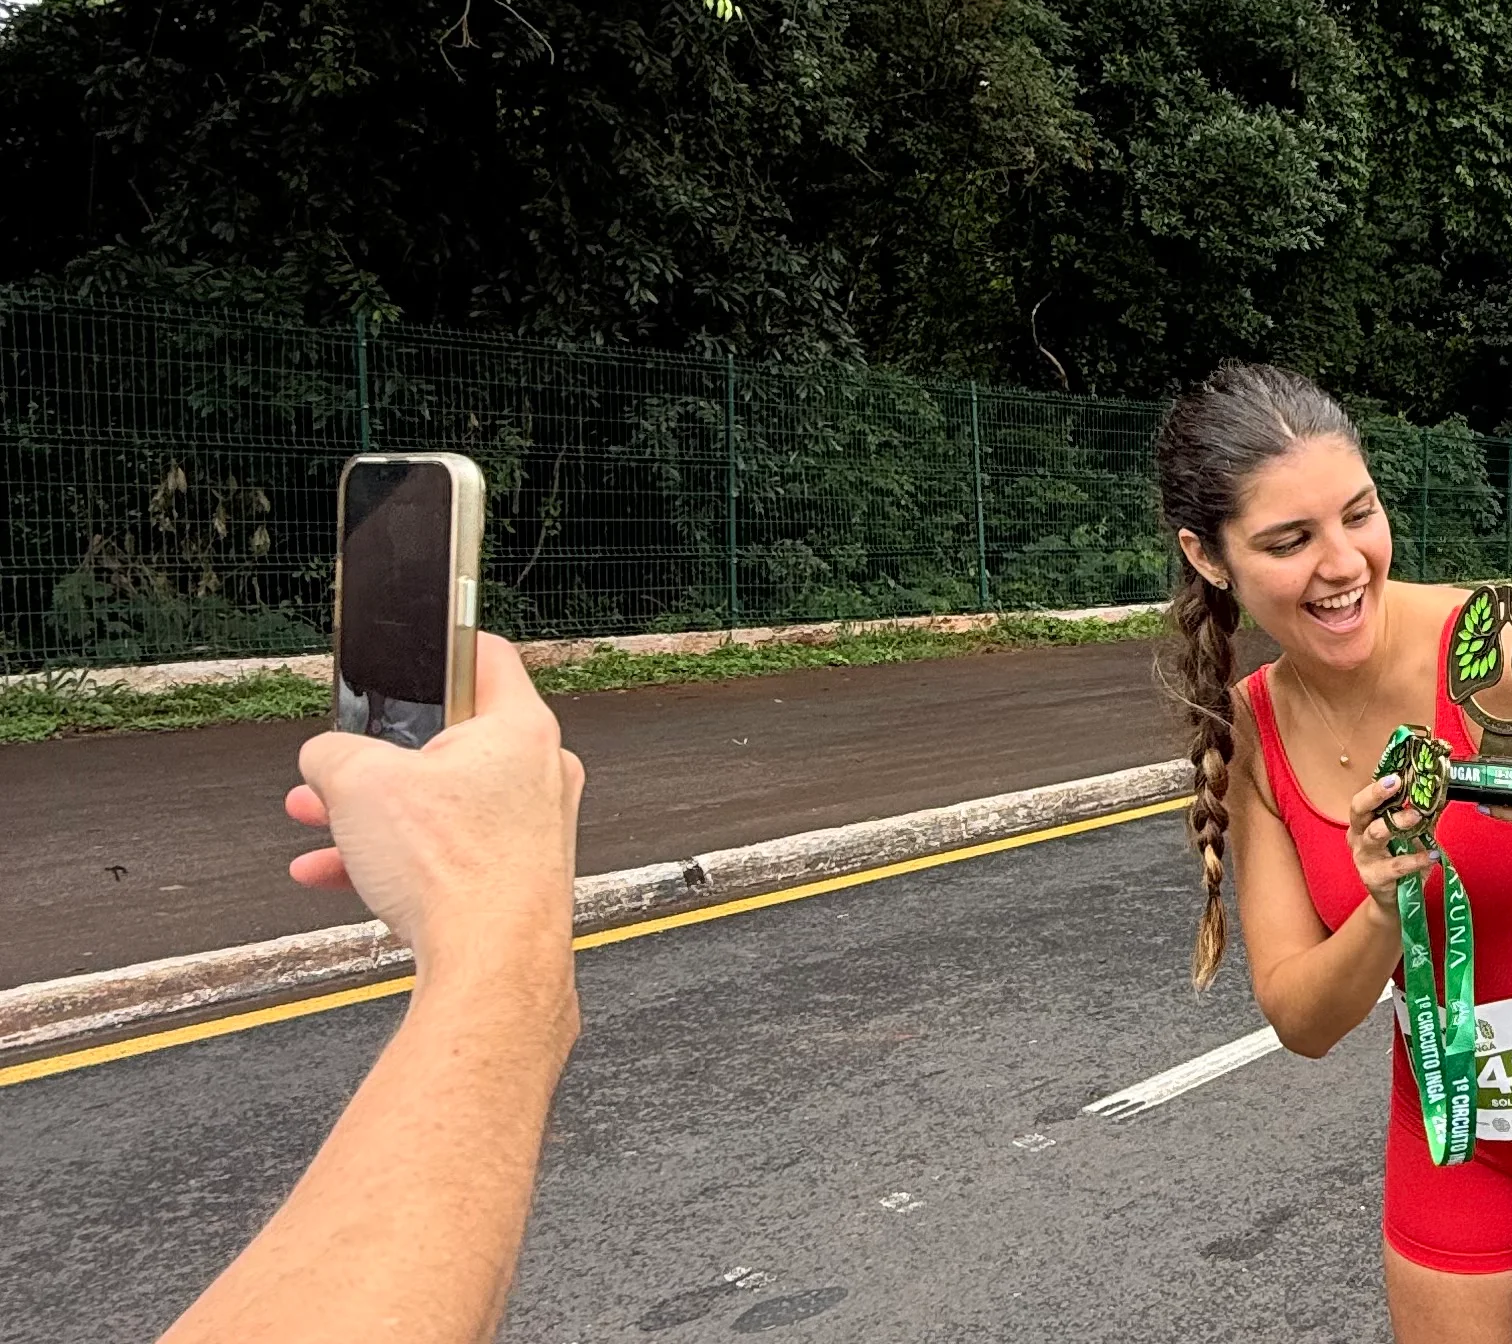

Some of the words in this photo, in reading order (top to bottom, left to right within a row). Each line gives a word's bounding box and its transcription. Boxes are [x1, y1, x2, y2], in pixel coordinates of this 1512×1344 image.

[1449, 765, 1481, 782] UGAR
[1447, 865, 1467, 969] ARUNA
[1417, 1011, 1440, 1070] CIRCUITO
[1450, 1094, 1470, 1153] CIRCUITO
